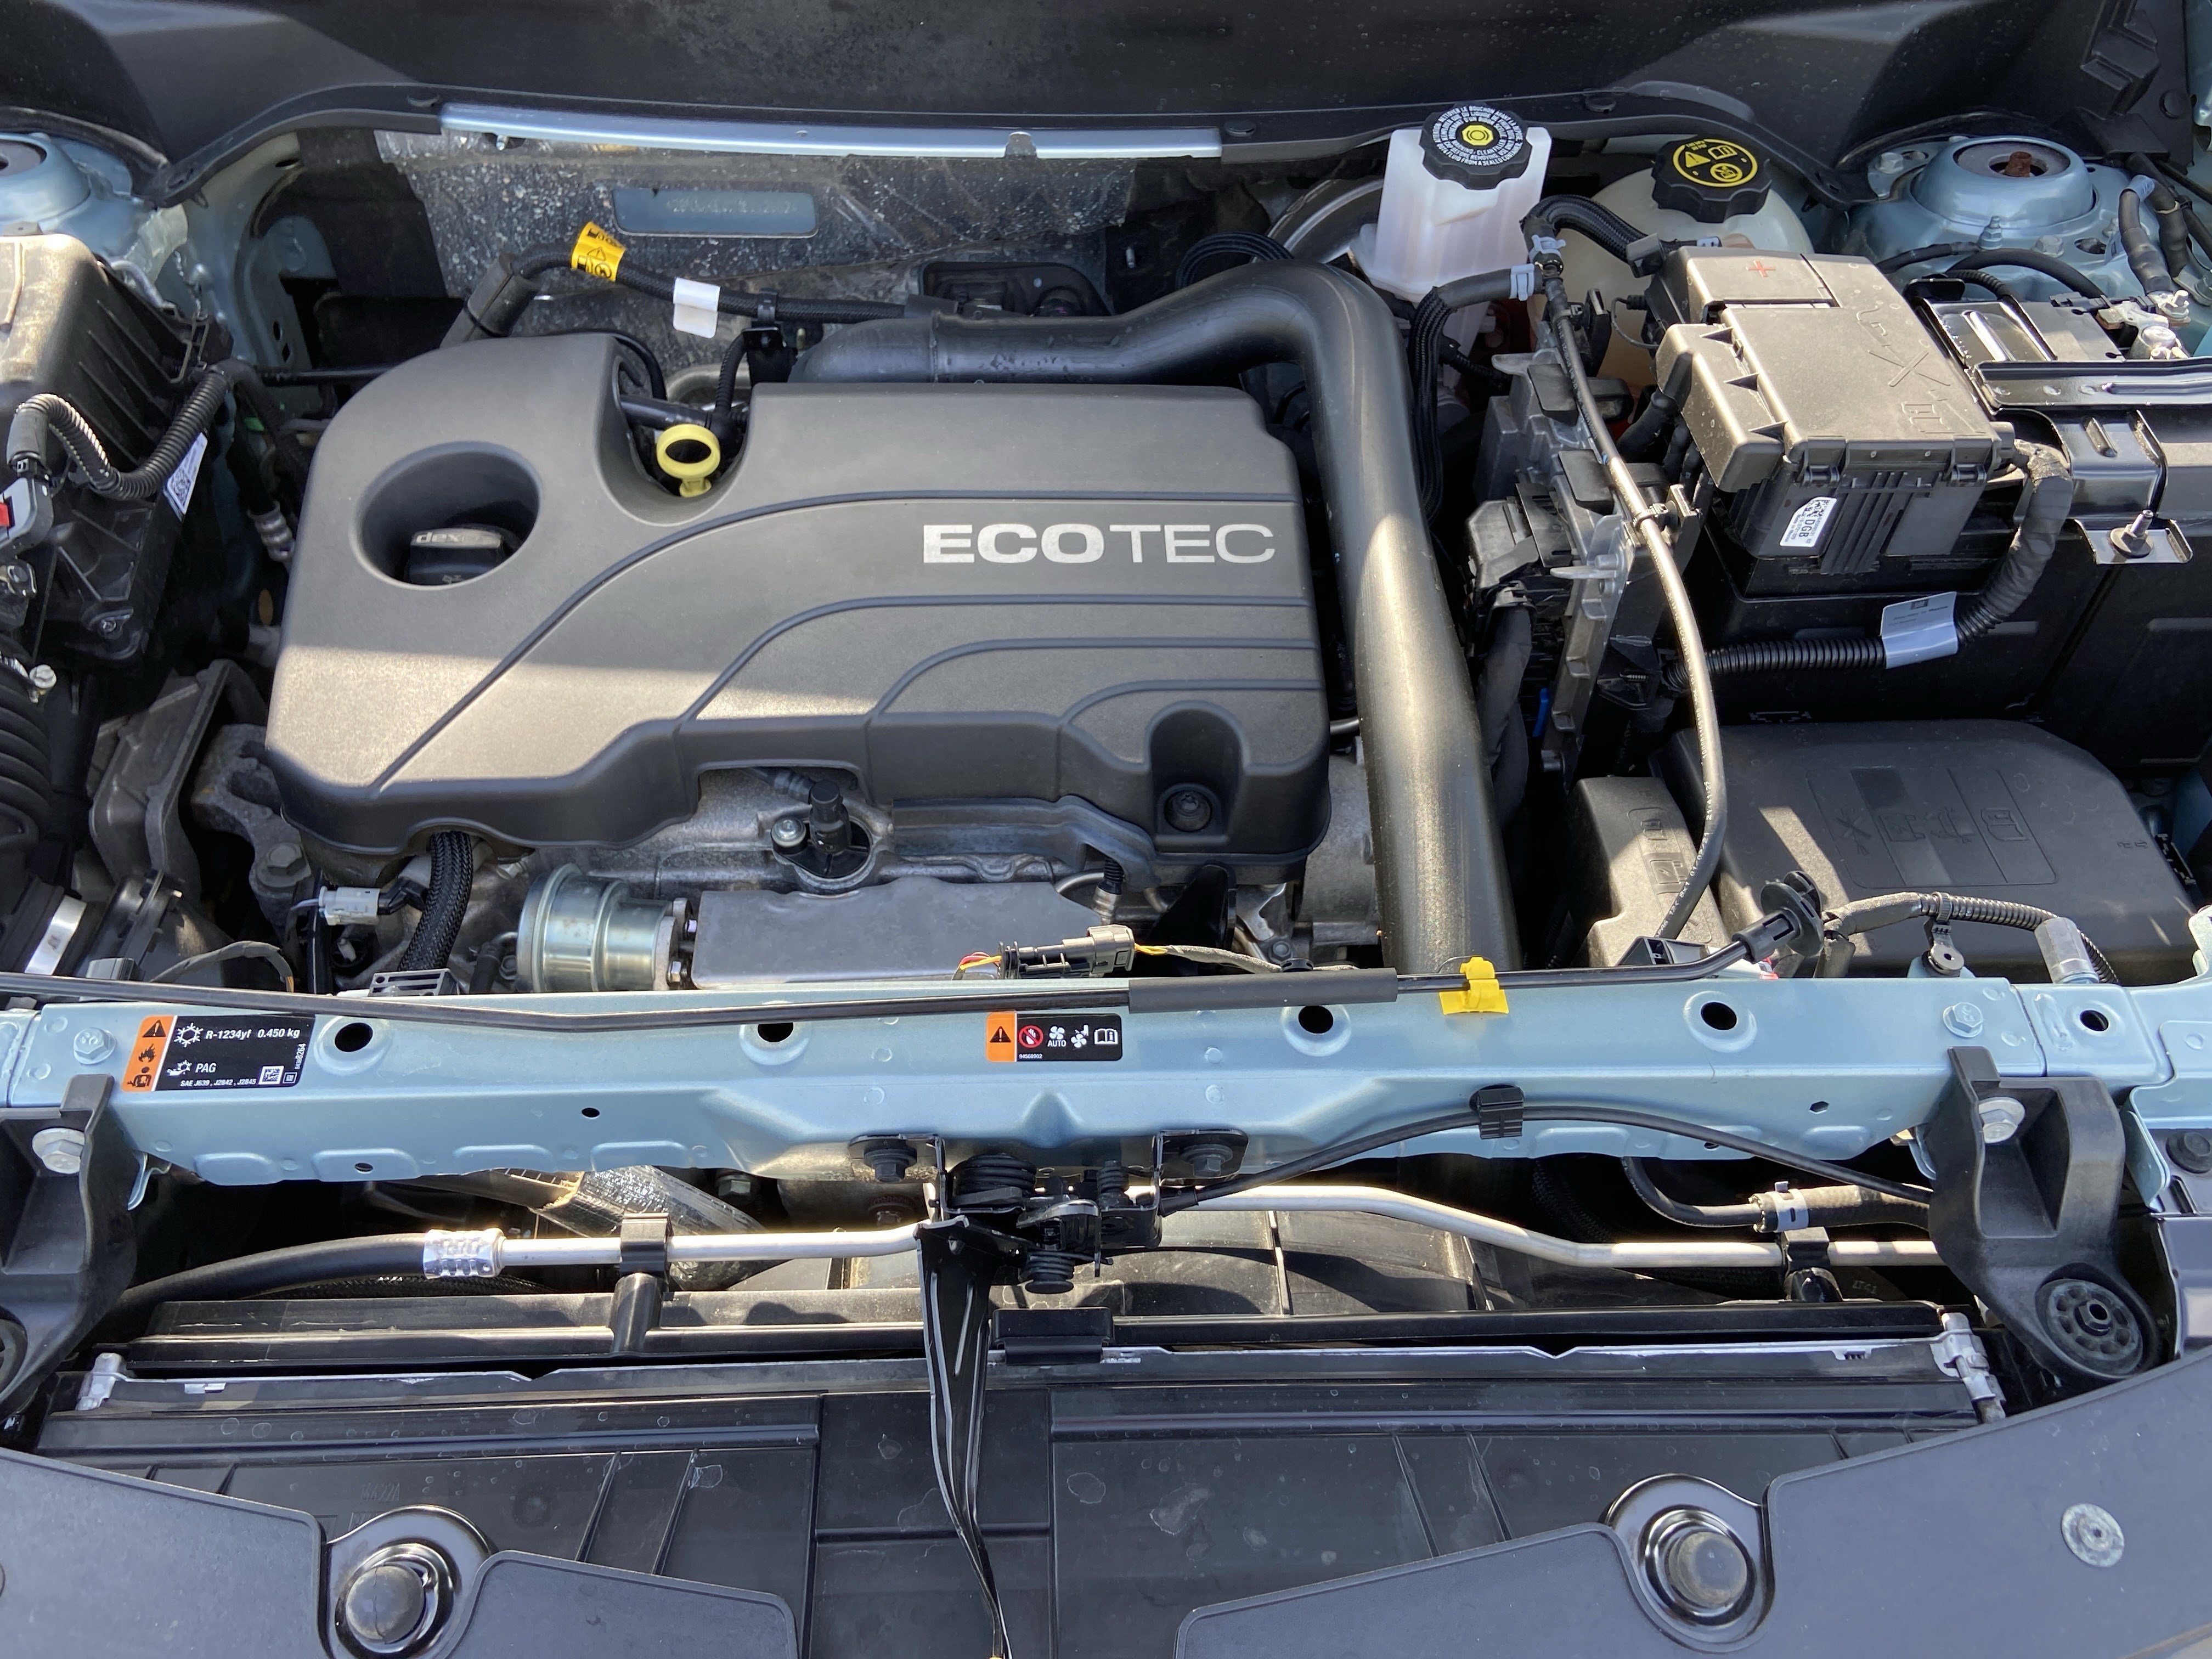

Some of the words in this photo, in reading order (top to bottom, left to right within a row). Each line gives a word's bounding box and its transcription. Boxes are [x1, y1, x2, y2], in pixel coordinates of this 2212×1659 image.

[1798, 520, 1816, 537] DGB
[923, 523, 1276, 563] ECOTEC
[206, 1029, 252, 1040] R-1234yf
[257, 1028, 285, 1038] 0.450
[287, 1028, 300, 1039] kg
[195, 1063, 217, 1073] PAG
